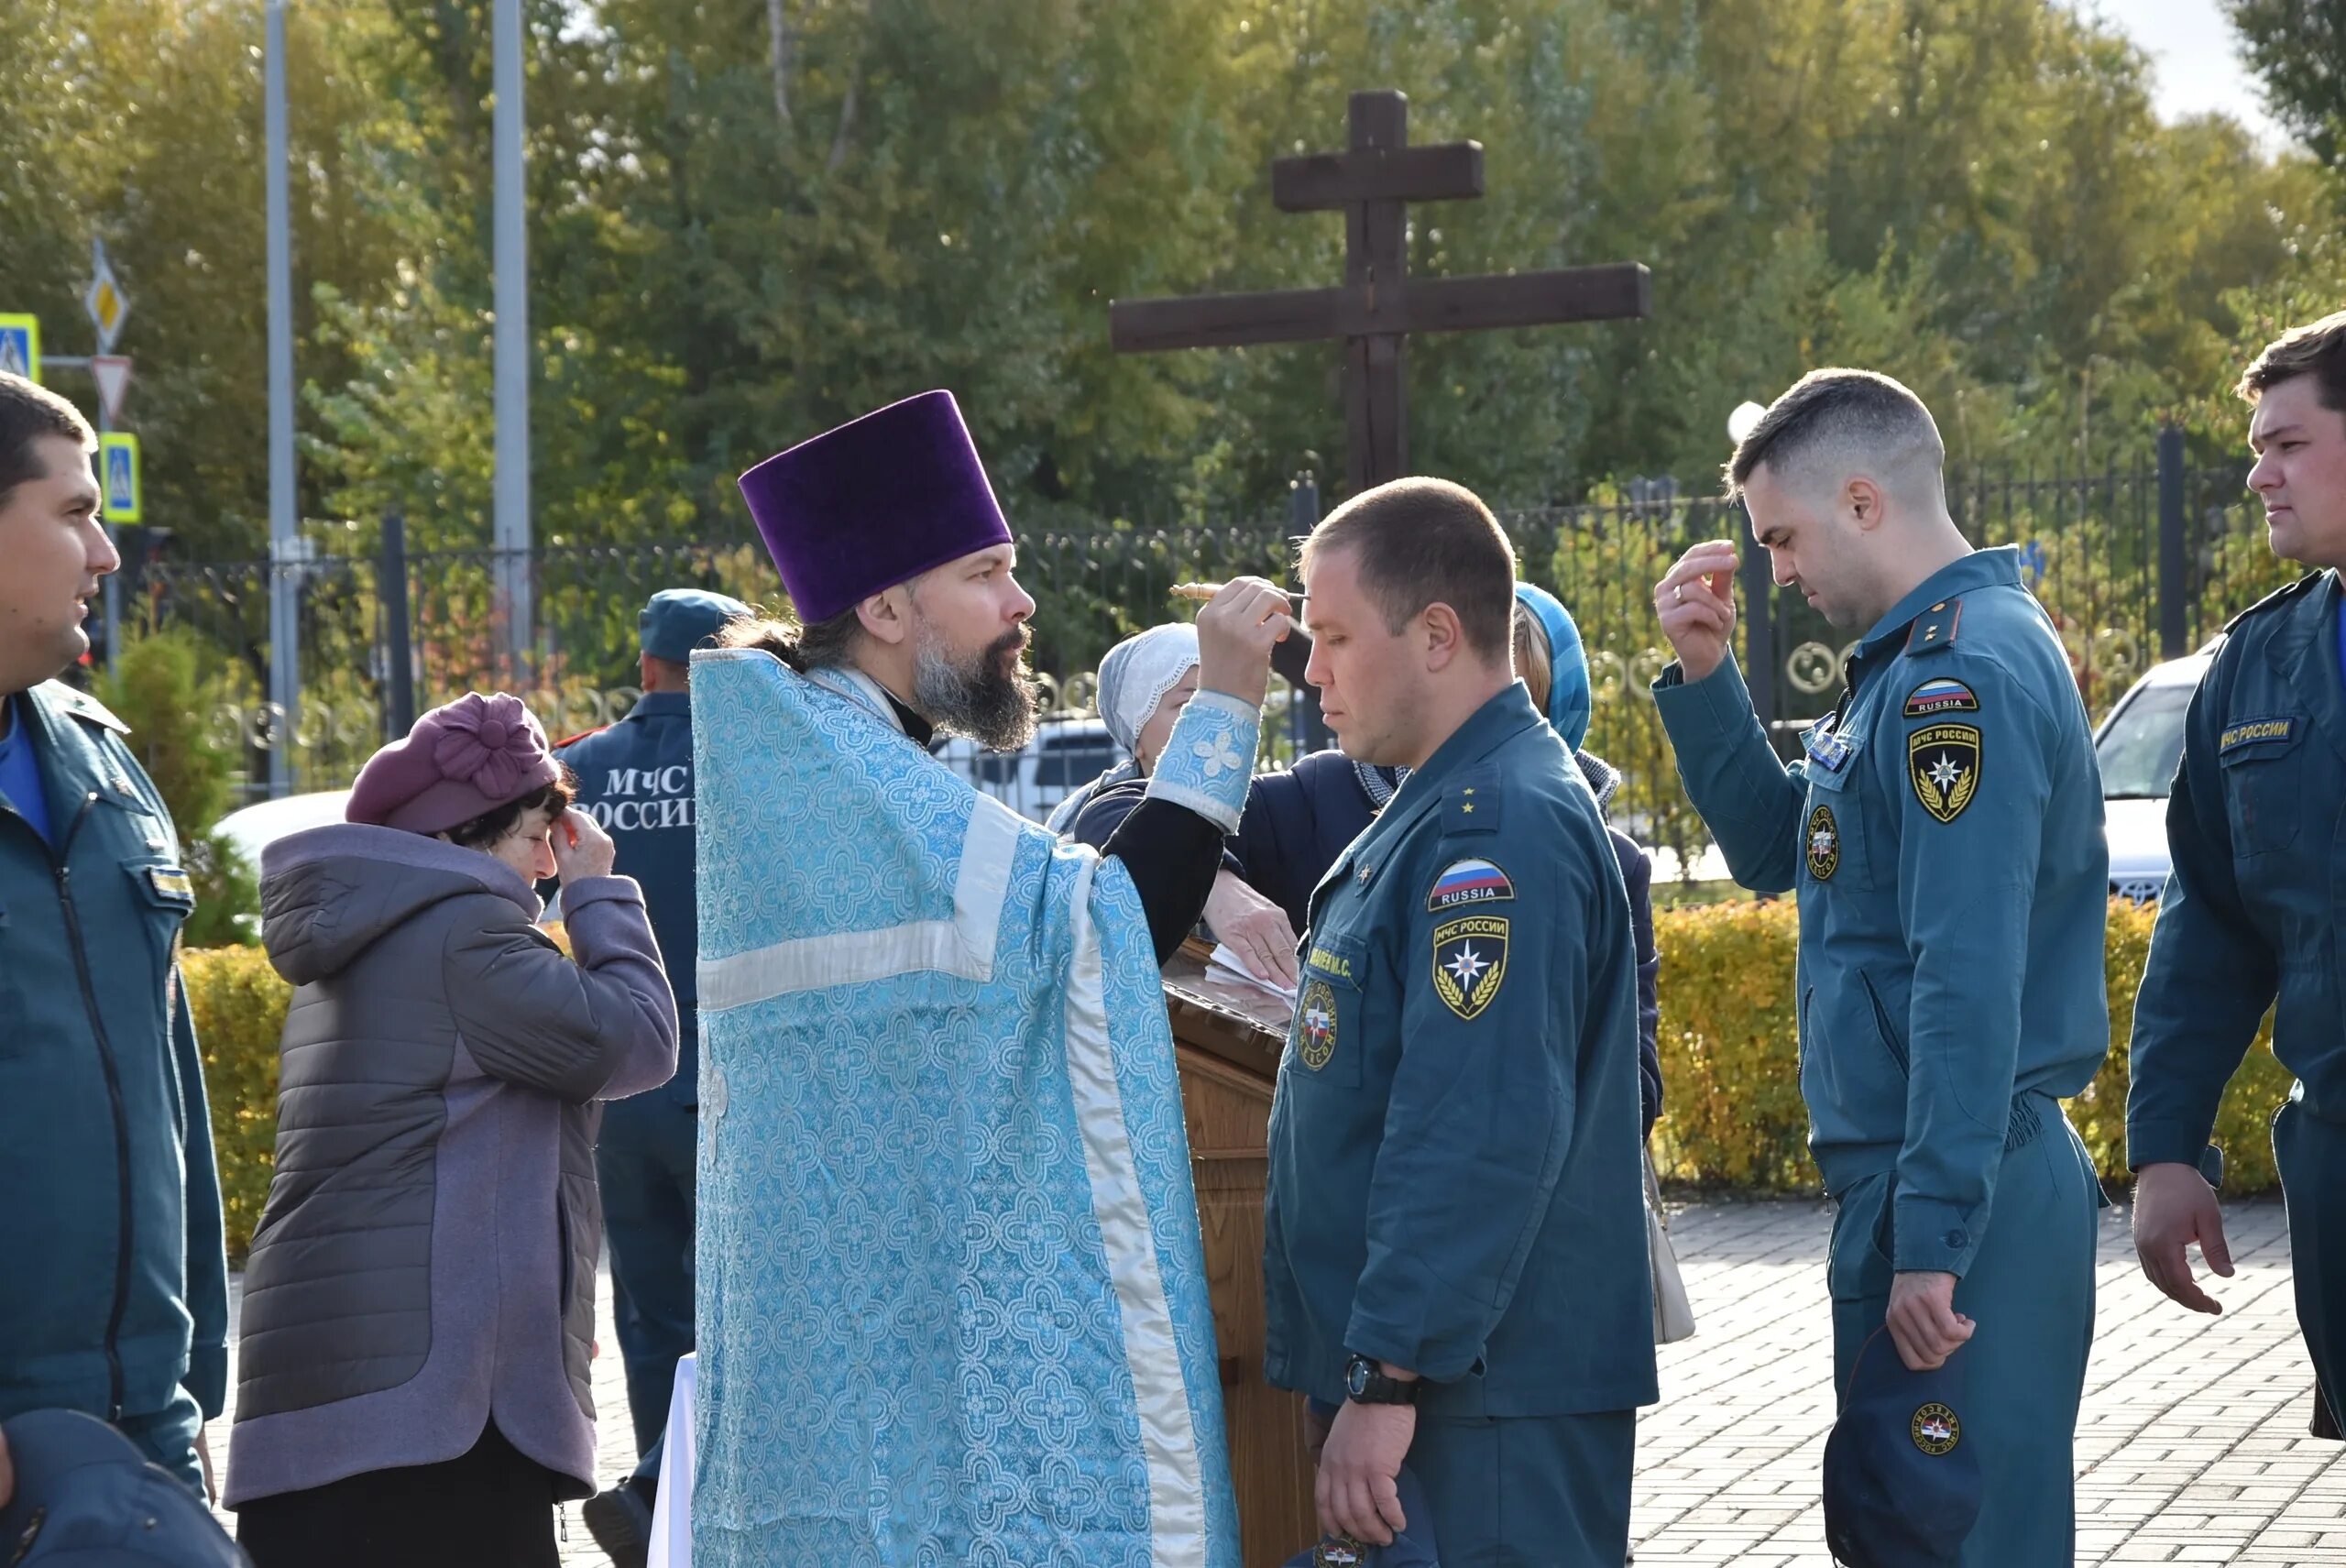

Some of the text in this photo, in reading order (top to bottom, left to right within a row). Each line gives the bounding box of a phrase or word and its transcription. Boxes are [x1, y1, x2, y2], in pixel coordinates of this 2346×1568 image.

[1918, 699, 1962, 712] RUSSIA
[1913, 729, 1976, 747] МЧС РОССИИ
[2239, 721, 2289, 741] РОССИИ
[601, 765, 687, 796] МЧС
[573, 797, 696, 830] ОССИ
[1442, 887, 1495, 905] RUSSIA
[1436, 920, 1505, 942] МЧС РОССИИ
